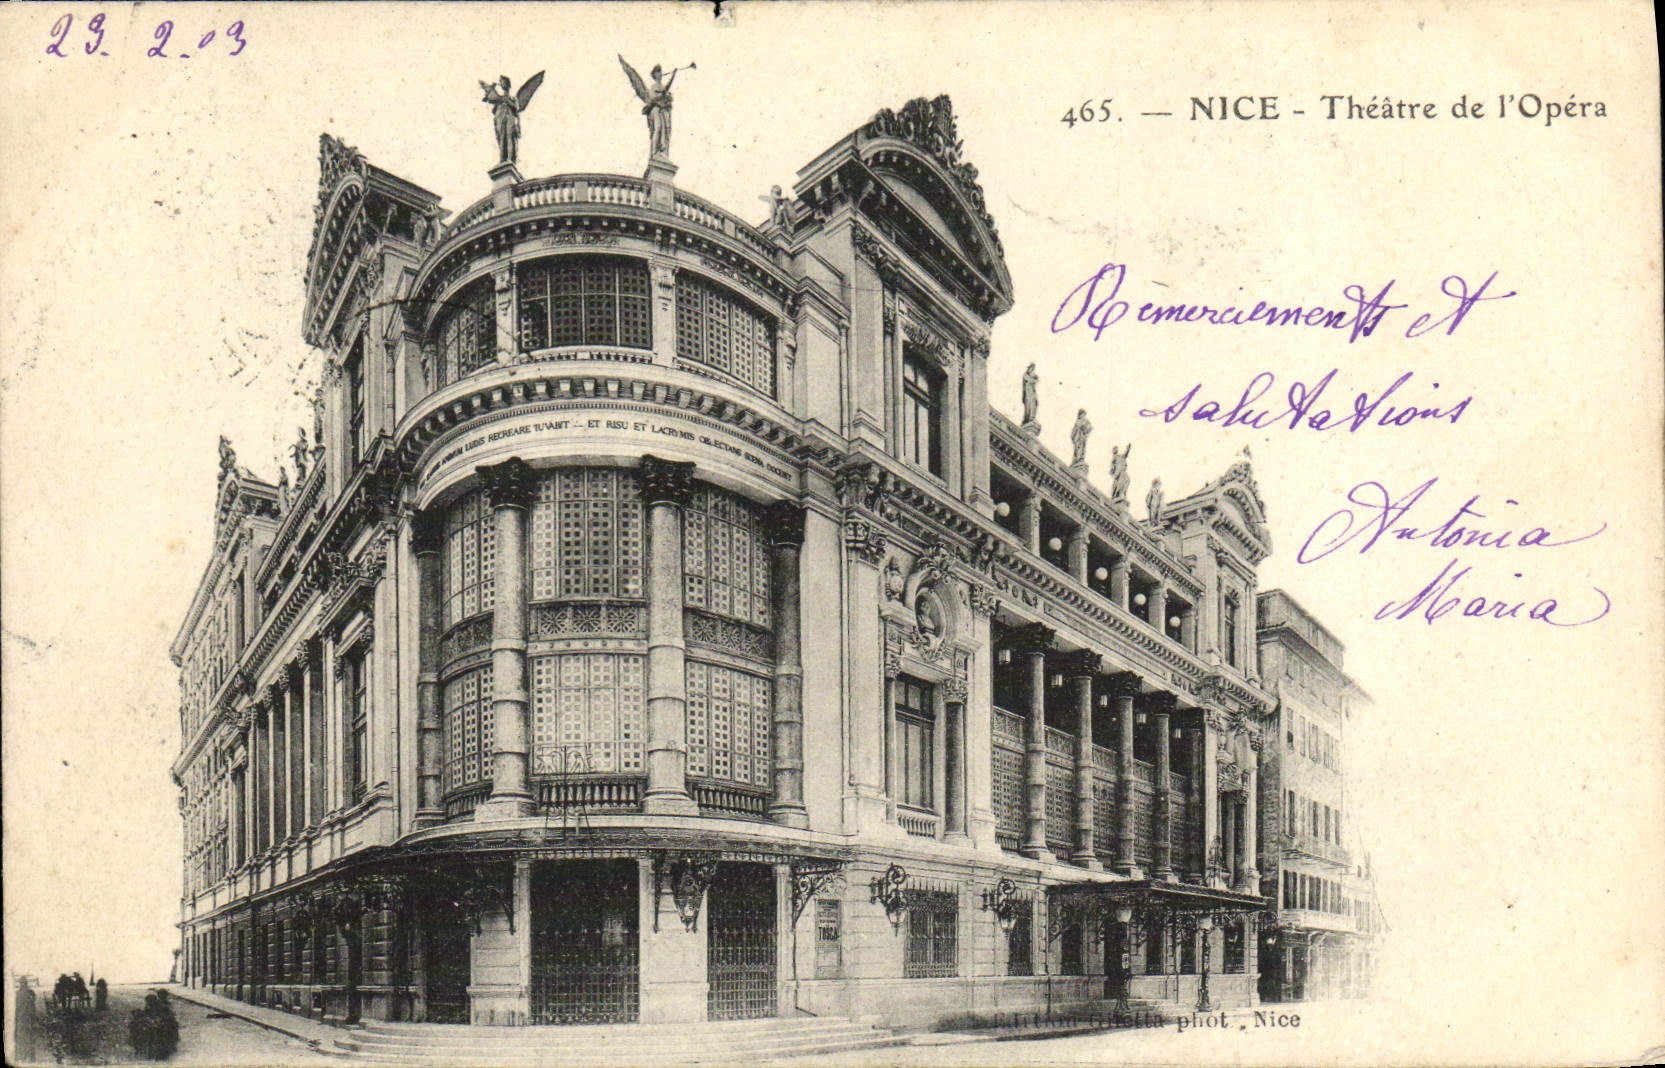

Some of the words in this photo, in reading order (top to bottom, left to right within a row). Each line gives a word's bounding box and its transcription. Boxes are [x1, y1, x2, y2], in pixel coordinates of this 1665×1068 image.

[488, 425, 531, 443] RECREARE
[588, 419, 600, 428] ET
[606, 420, 628, 430] RISU
[633, 422, 647, 432] ET
